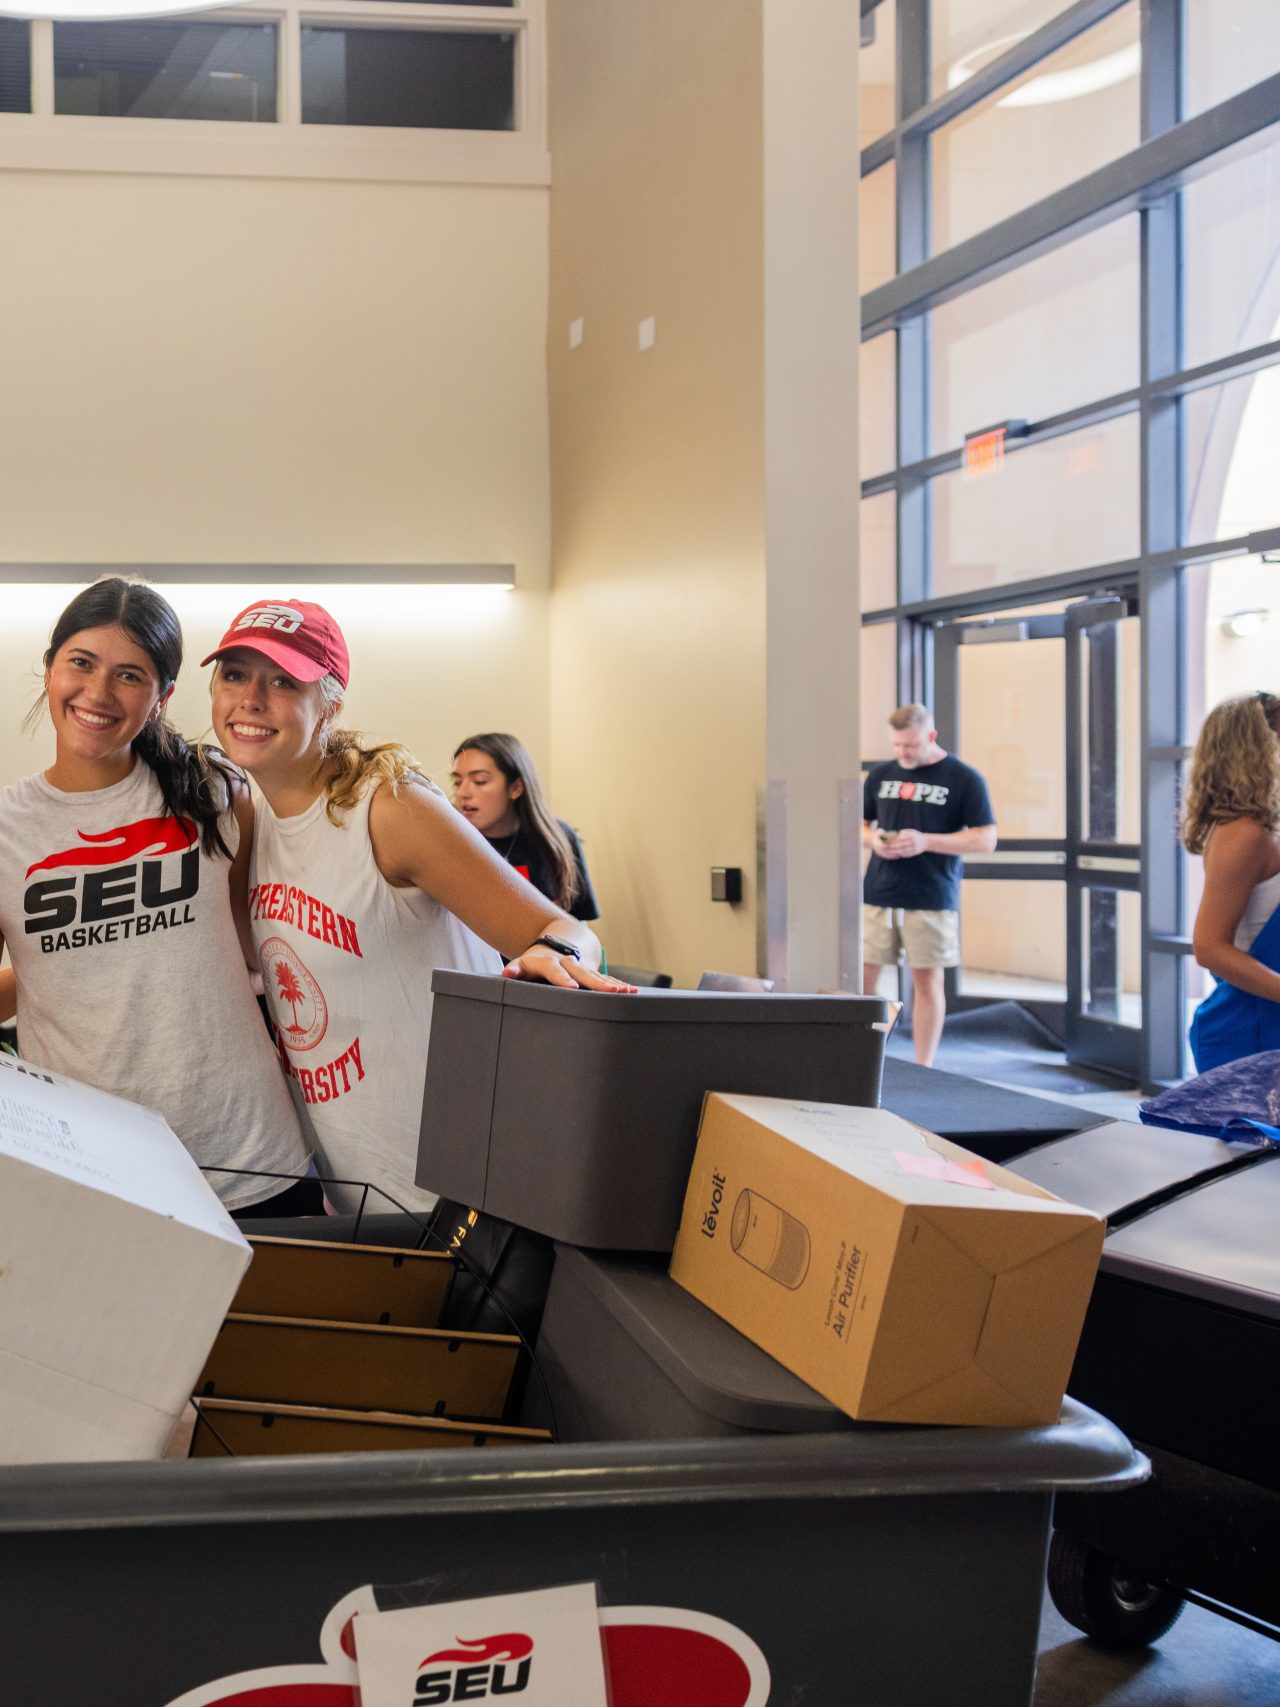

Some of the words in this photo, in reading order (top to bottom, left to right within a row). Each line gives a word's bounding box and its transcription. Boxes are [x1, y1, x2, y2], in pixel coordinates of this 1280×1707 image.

[234, 613, 300, 634] SEU
[24, 847, 200, 934] SEU
[41, 904, 196, 953] BASKETBALL
[839, 1245, 861, 1308] Purifier
[833, 1310, 847, 1338] Air
[413, 1656, 532, 1707] SEU
